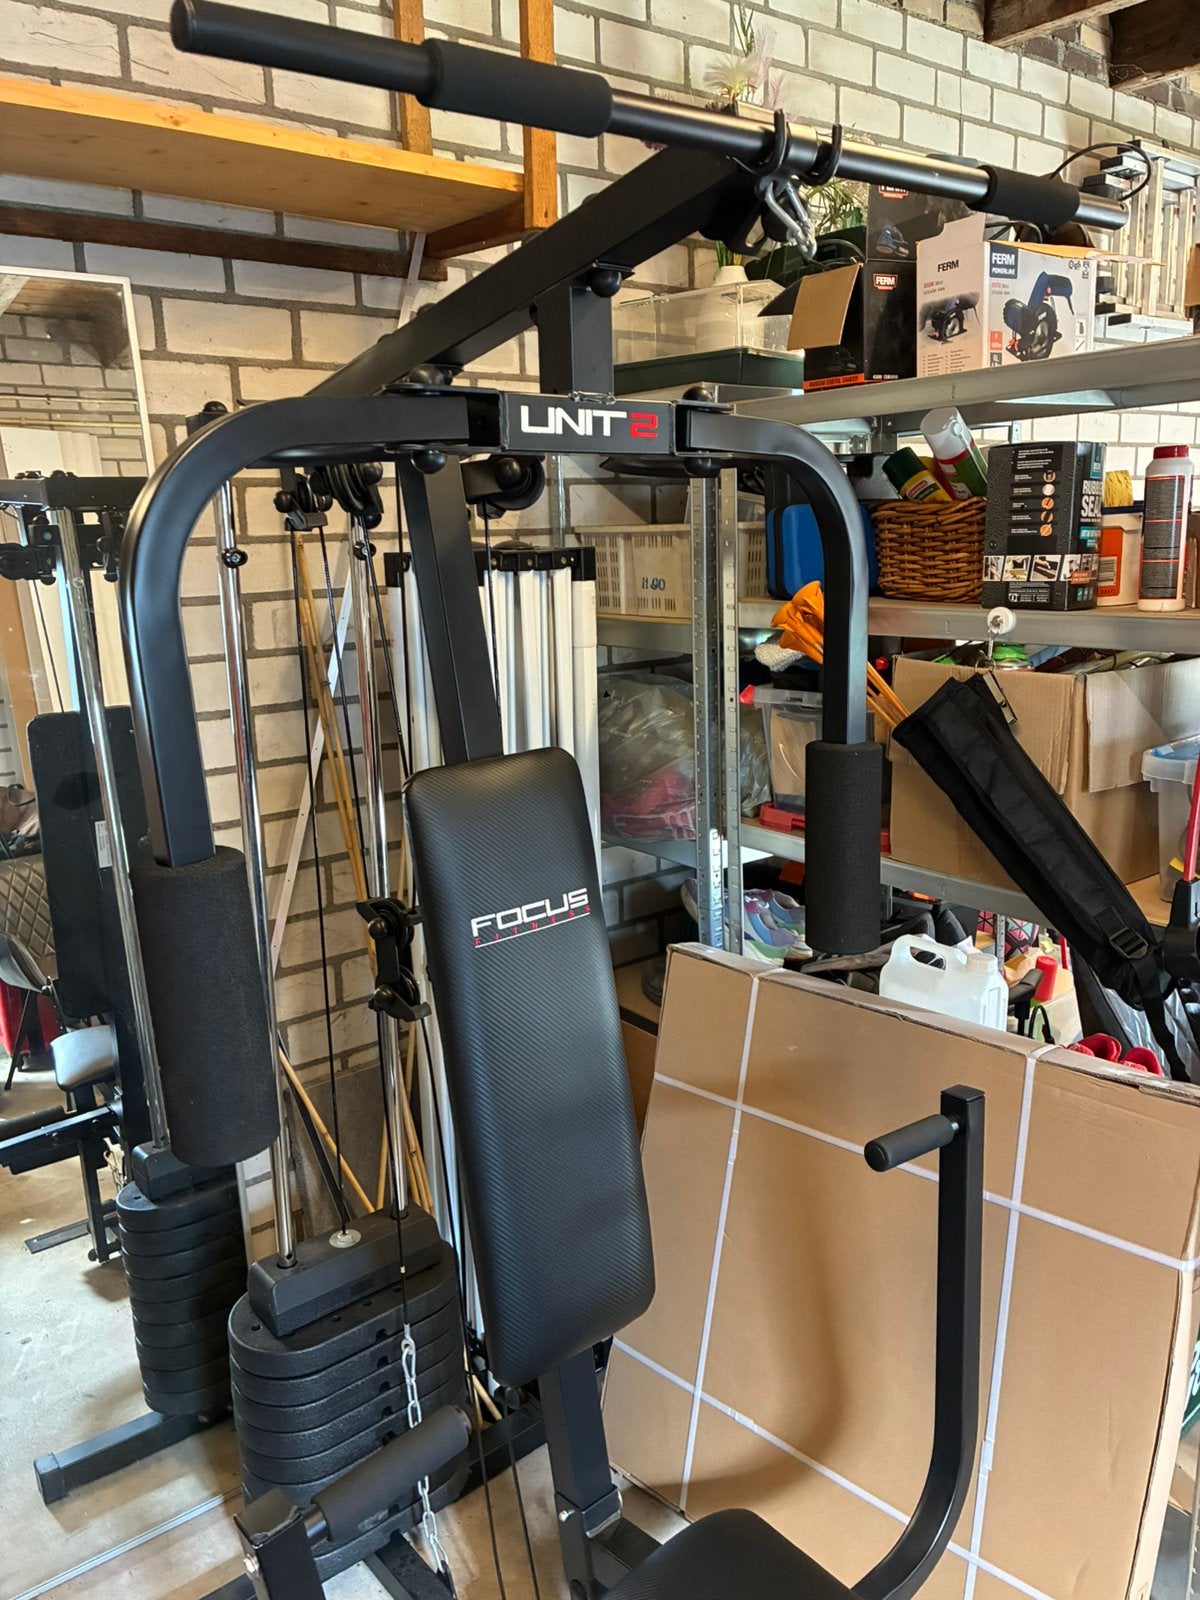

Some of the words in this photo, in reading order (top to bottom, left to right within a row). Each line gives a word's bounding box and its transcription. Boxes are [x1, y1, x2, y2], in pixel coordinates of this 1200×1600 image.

[937, 259, 960, 273] FERM
[991, 252, 1016, 266] FERM
[875, 276, 896, 286] FERM
[520, 405, 627, 437] UNIT
[630, 412, 659, 439] 2
[470, 887, 589, 938] FOCUS
[473, 903, 591, 946] FITNESS
